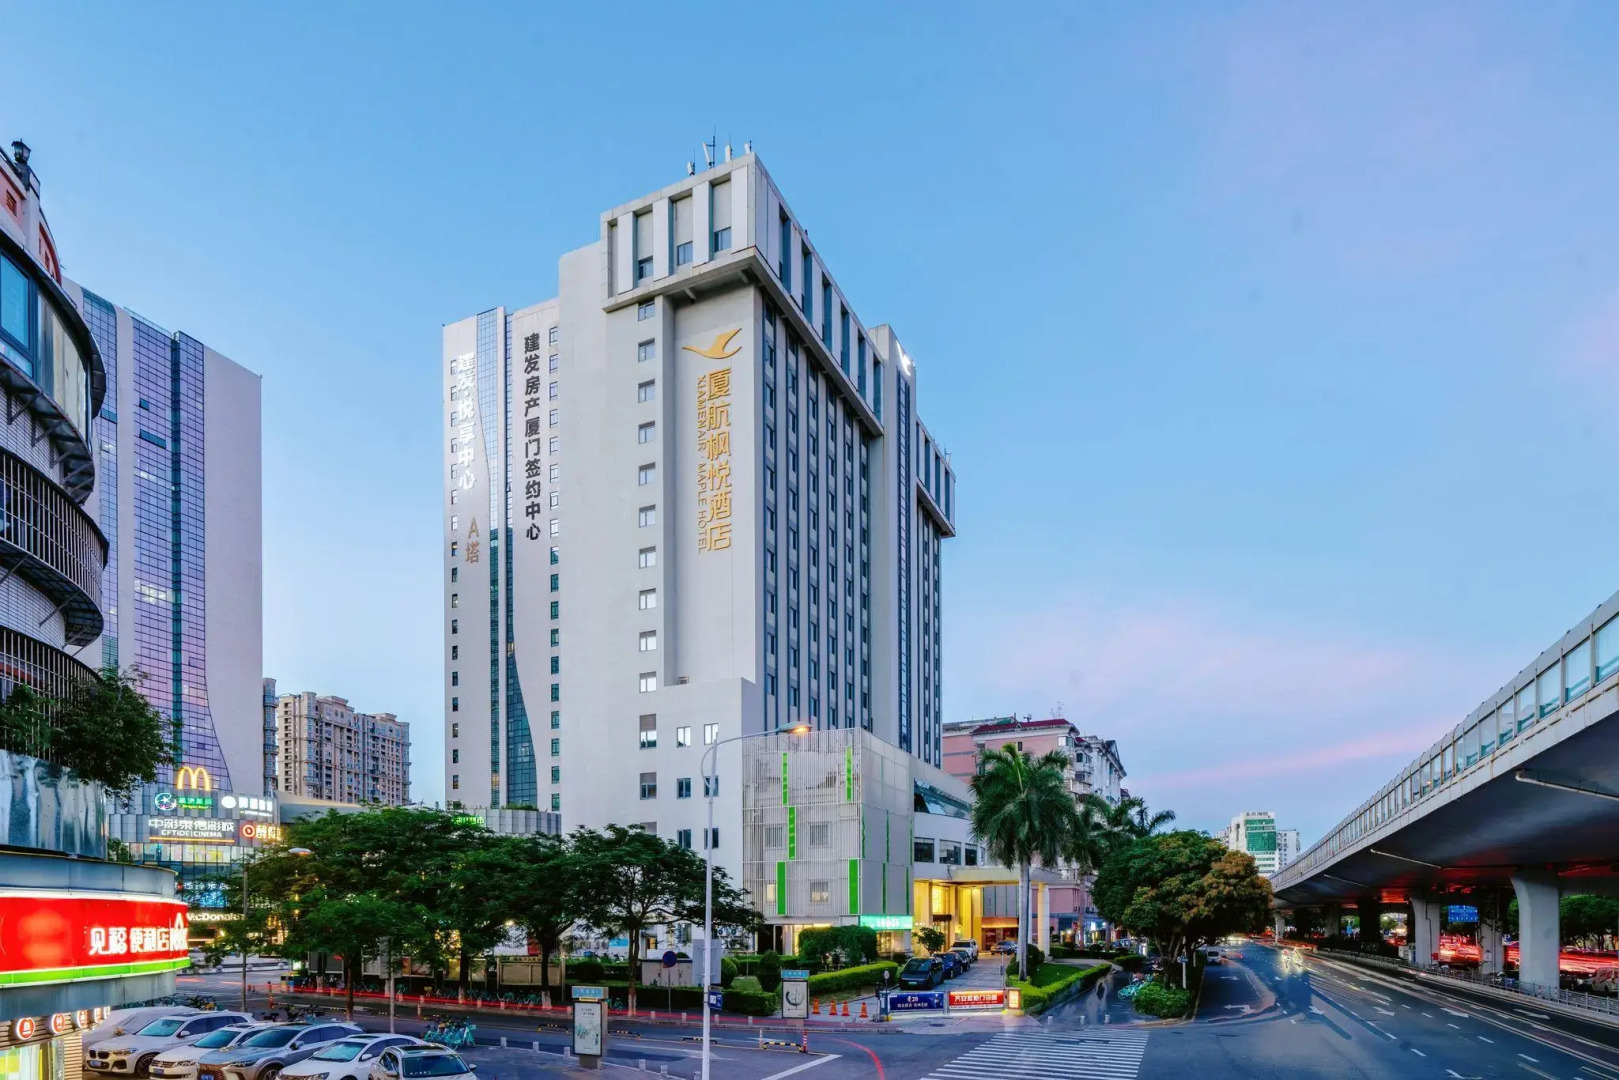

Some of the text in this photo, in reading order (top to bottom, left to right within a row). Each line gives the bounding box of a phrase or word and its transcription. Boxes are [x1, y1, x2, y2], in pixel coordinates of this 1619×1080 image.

[523, 332, 541, 541] 建发房产厦门签约中心
[707, 367, 732, 551] 厦航枫悦酒店
[193, 830, 222, 838] CINEMA
